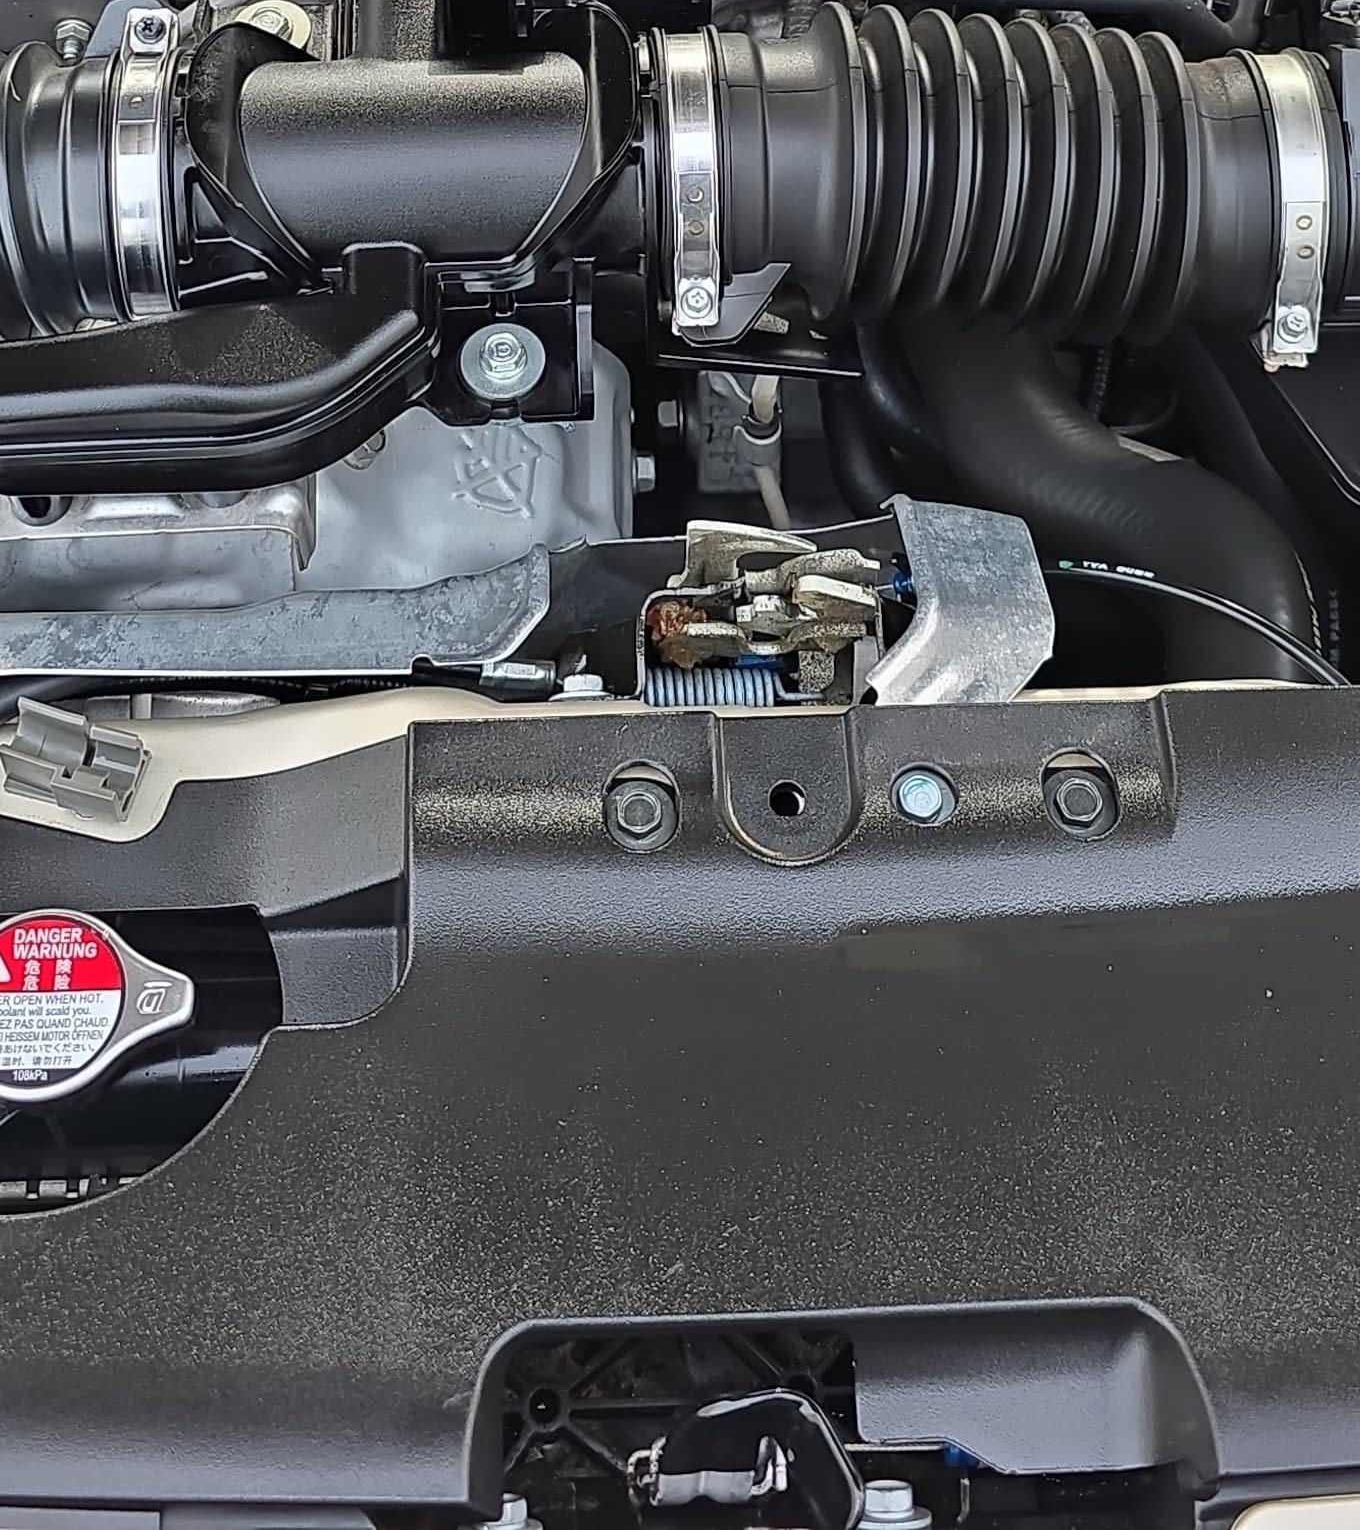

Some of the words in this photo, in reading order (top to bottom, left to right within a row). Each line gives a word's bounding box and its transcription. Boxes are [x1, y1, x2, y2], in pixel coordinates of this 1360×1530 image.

[13, 928, 83, 944] DANGER
[13, 942, 98, 960] WARNUNG
[13, 995, 44, 1005] OPEN
[45, 994, 78, 1005] WHEN
[79, 994, 104, 1004] HOT.
[27, 1006, 44, 1016] will
[45, 1006, 71, 1016] scald
[72, 1007, 92, 1017] you.
[14, 1018, 36, 1030] PAS
[37, 1017, 72, 1029] QUAND
[73, 1017, 110, 1029] CHAUD.
[4, 1031, 40, 1042] HEISSEM
[41, 1031, 71, 1041] MOTOR
[12, 1070, 48, 1082] 108kPa
